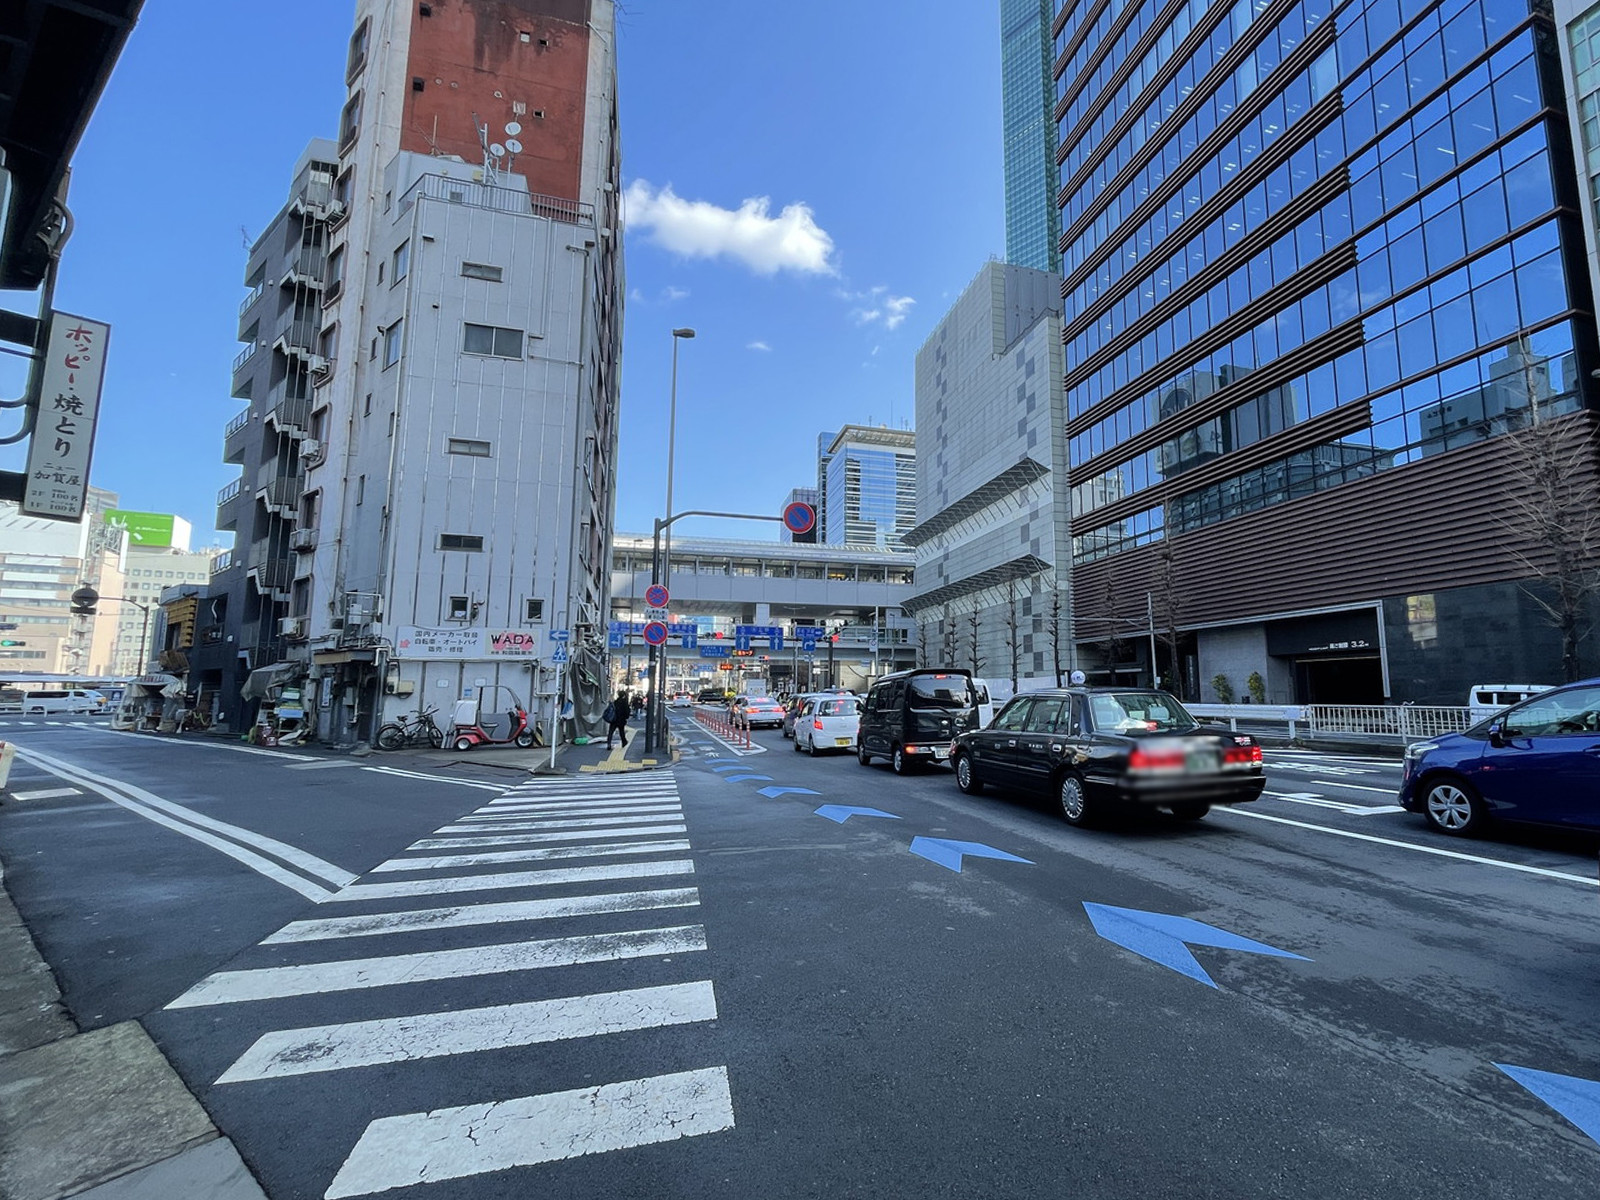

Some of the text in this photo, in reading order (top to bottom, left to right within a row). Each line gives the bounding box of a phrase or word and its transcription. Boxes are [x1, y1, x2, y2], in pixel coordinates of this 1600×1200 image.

[53, 323, 93, 458] ホッピー・焼とり
[490, 634, 535, 645] WADA
